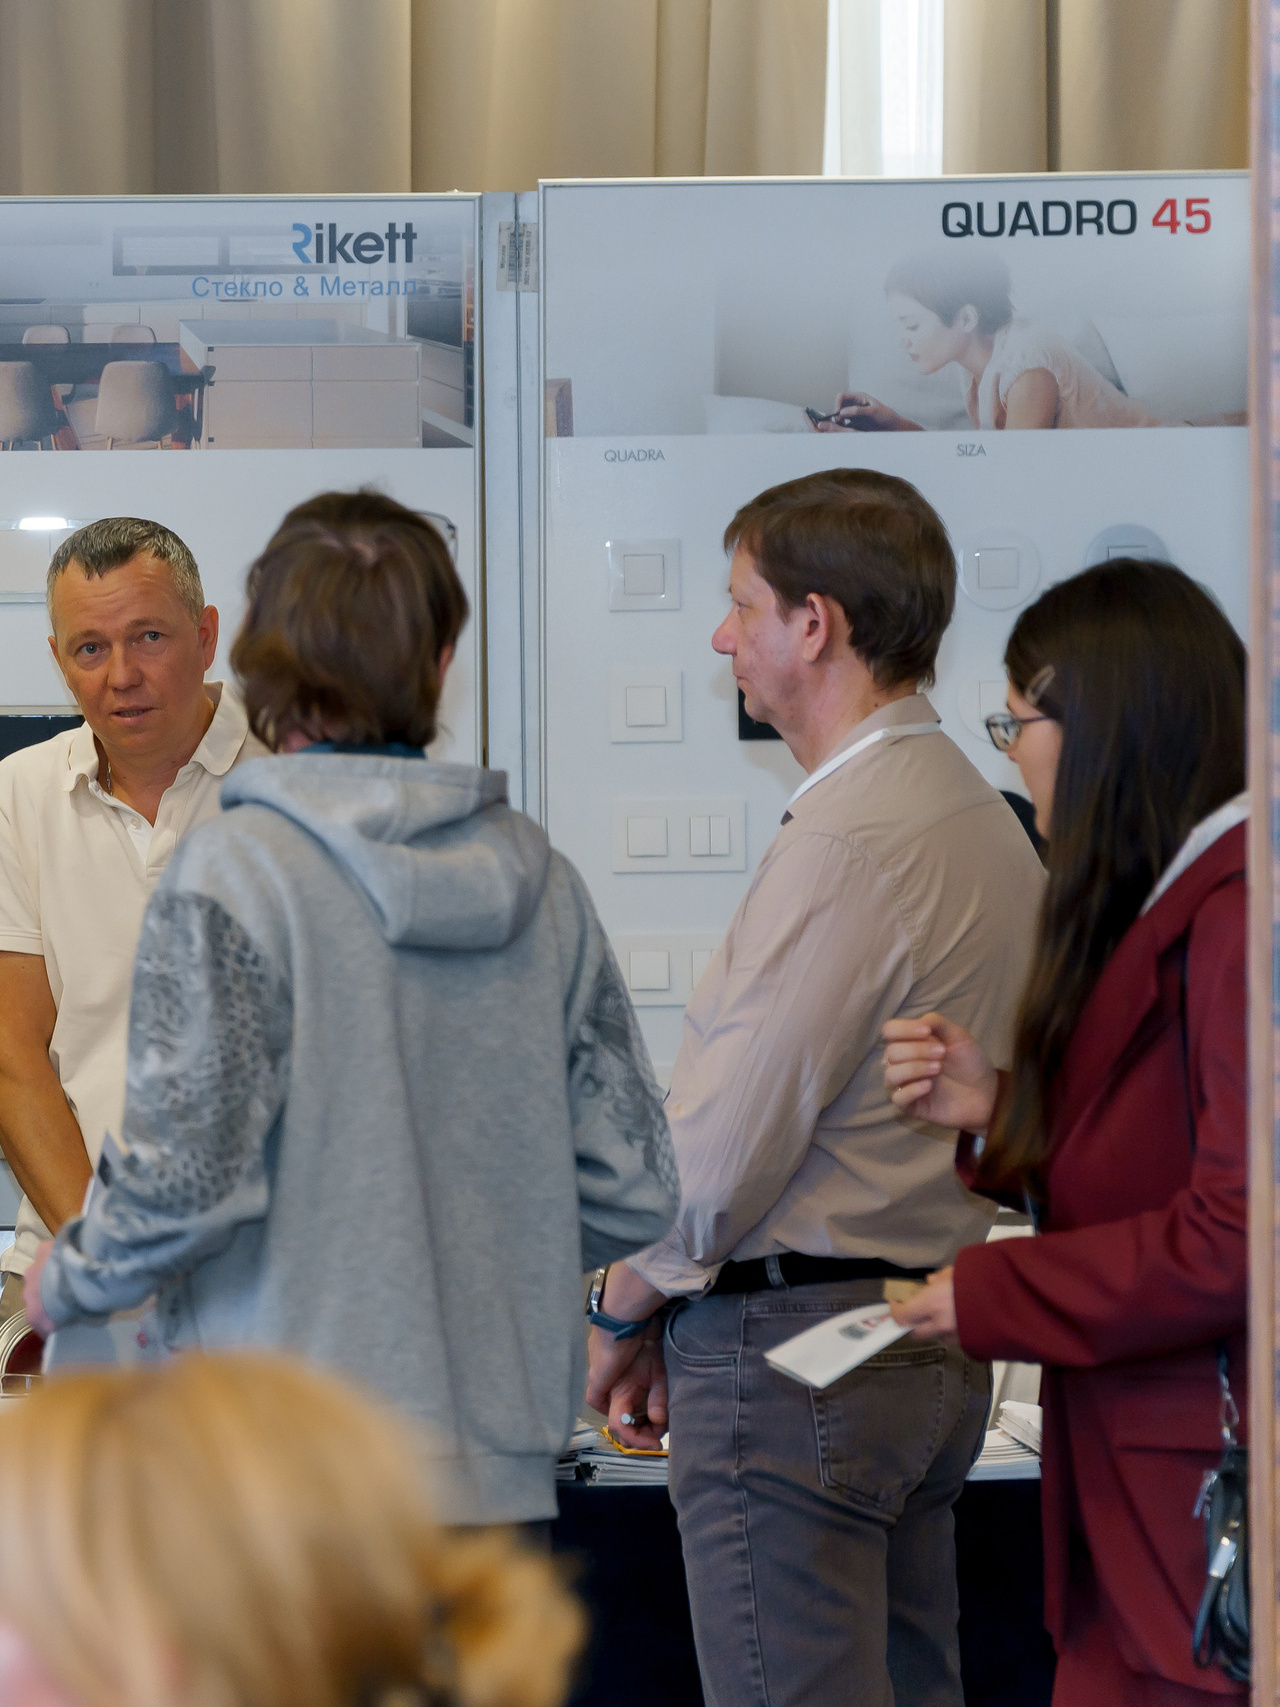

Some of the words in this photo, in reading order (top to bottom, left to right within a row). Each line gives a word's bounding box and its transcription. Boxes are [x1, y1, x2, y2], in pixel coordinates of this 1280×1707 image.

[941, 199, 1138, 238] QUADRO
[1151, 197, 1213, 235] 45
[291, 222, 418, 265] Rikett
[191, 276, 284, 298] Стекло
[292, 275, 310, 297] &
[320, 275, 418, 297] Металл
[604, 448, 667, 463] QUADRA
[956, 443, 988, 457] SIZA
